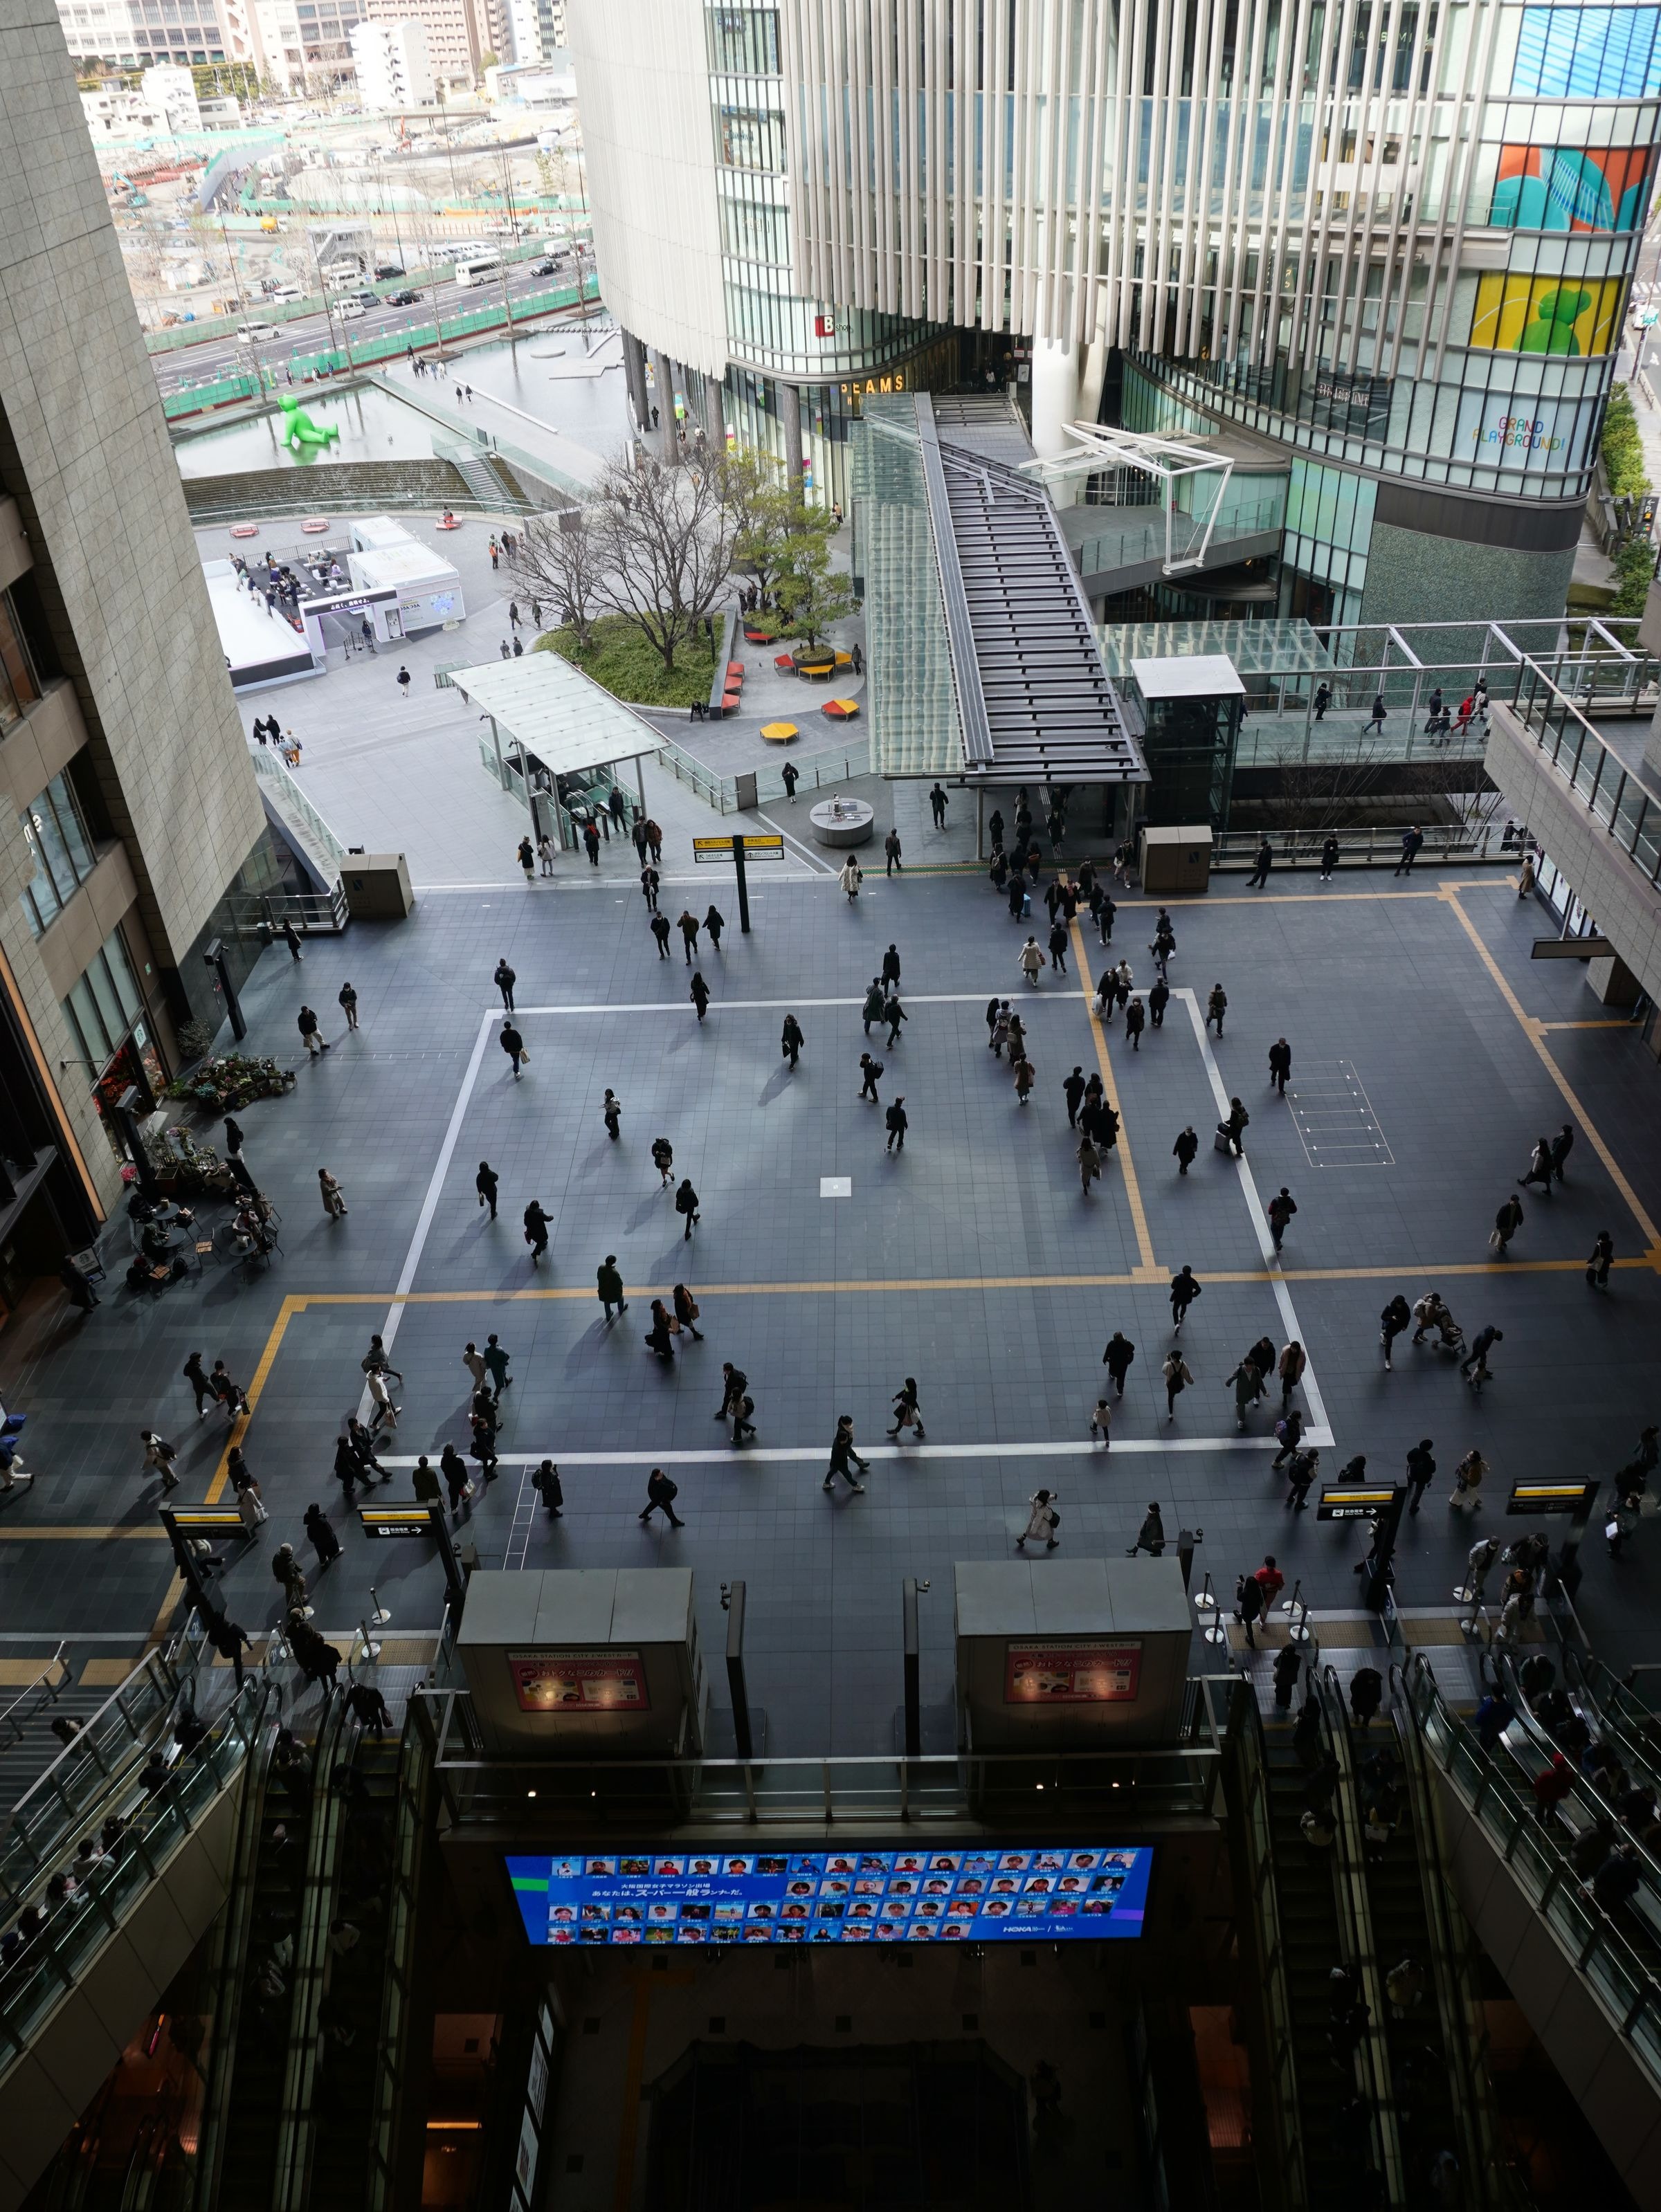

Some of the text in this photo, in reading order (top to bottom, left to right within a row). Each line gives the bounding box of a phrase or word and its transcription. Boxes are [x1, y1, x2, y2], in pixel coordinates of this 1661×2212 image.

[841, 375, 903, 394] BEAMS
[1498, 417, 1544, 434] GRAND
[1472, 428, 1565, 450] PLAYGROUND!
